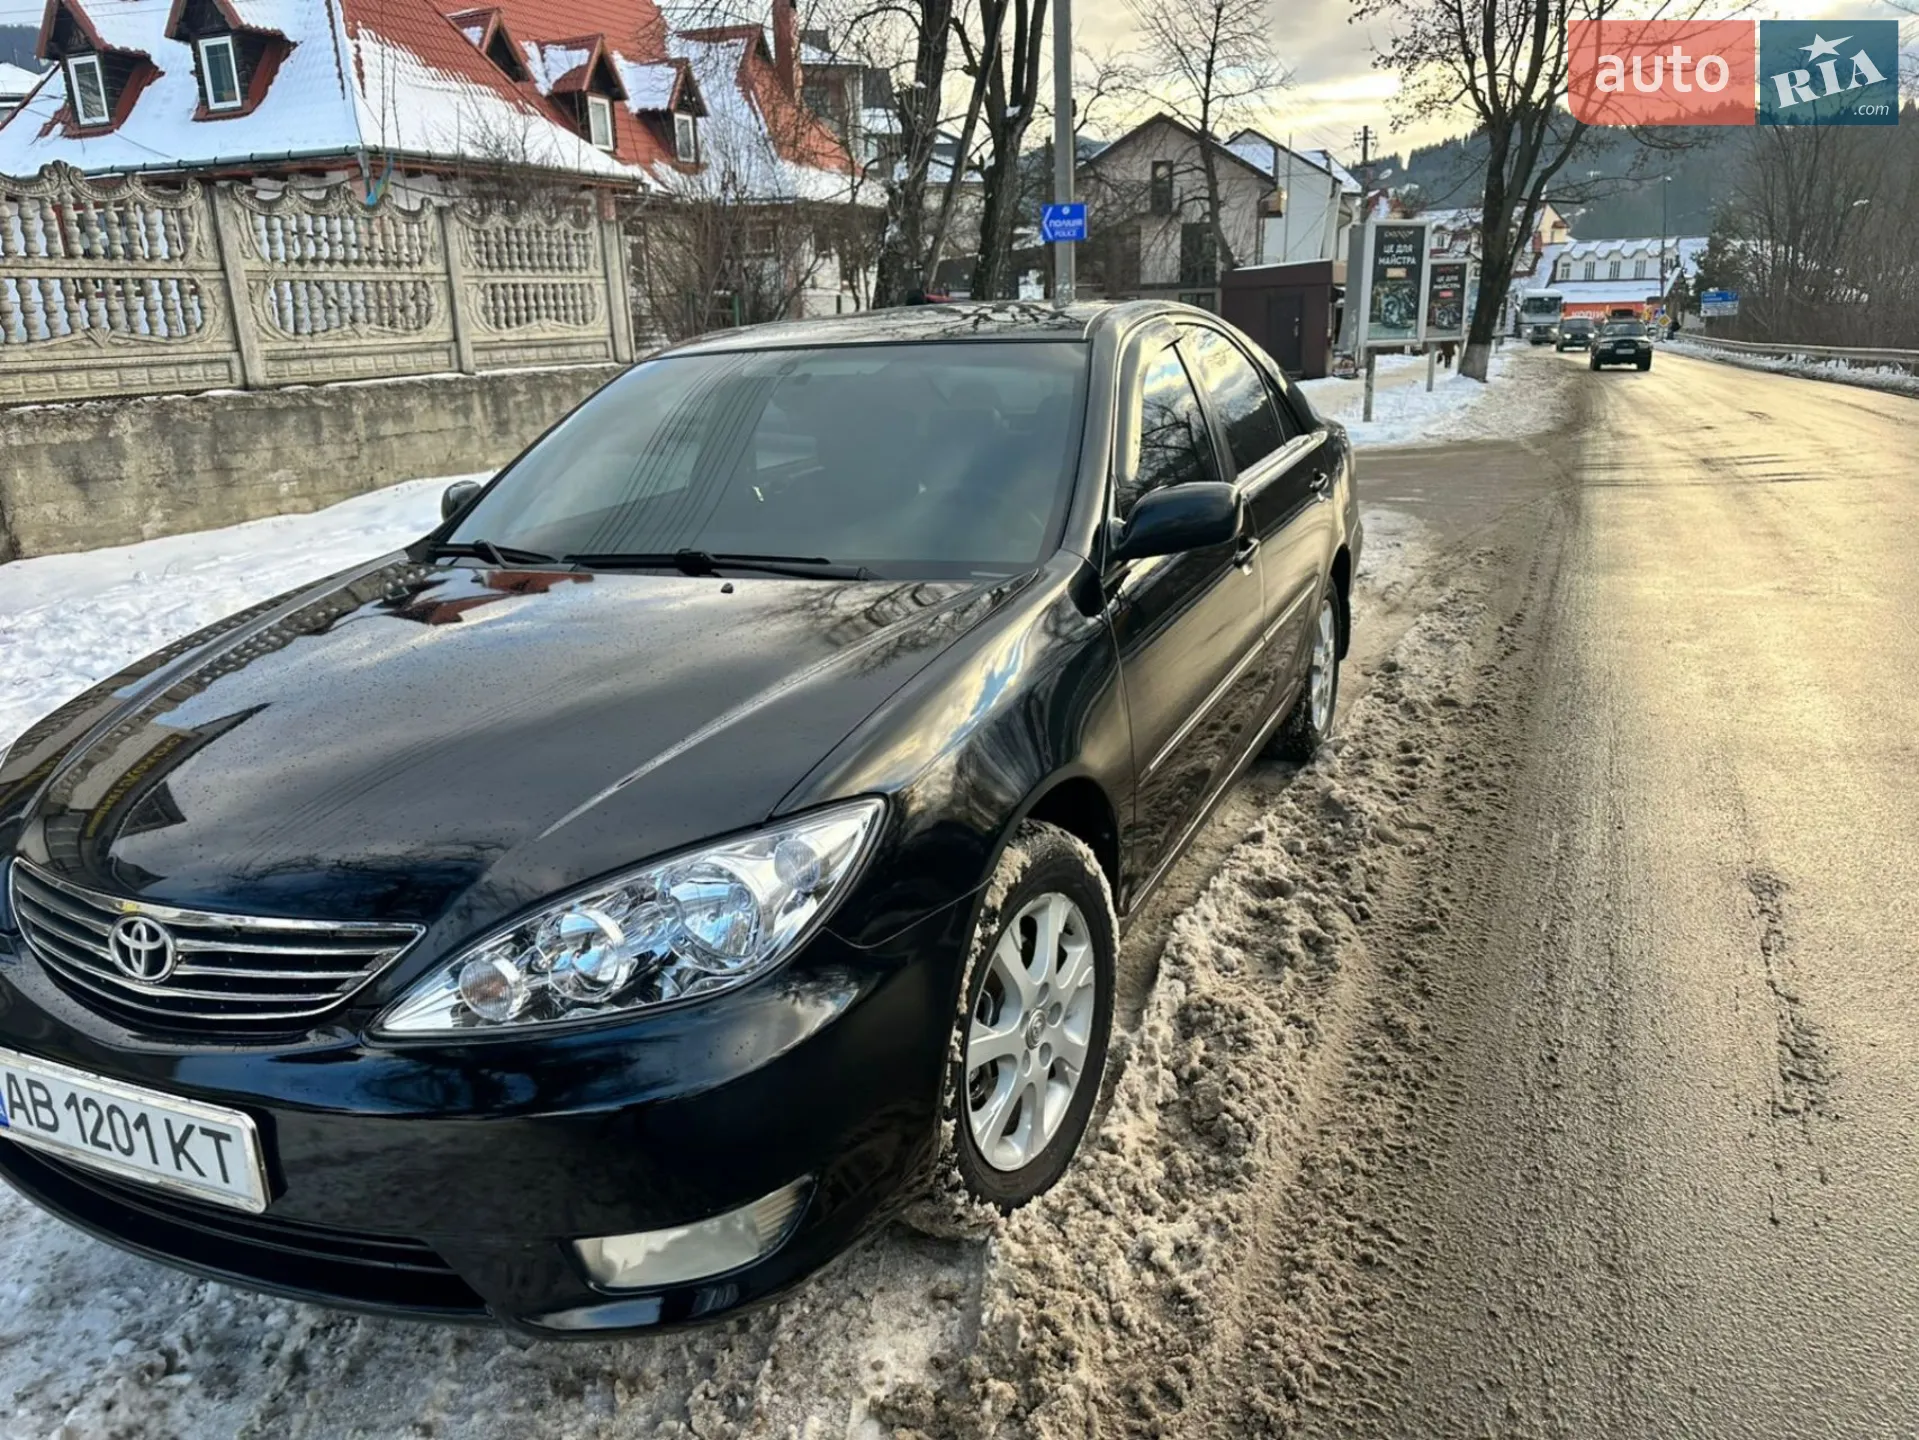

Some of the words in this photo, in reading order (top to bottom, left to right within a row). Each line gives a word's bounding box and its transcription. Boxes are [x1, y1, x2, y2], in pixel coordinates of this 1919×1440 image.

[1395, 243, 1414, 254] ДЛЯ
[1378, 253, 1417, 265] МАЙСТРА
[6, 1072, 60, 1133] AB
[64, 1091, 160, 1165] 1201
[164, 1118, 232, 1184] KT
